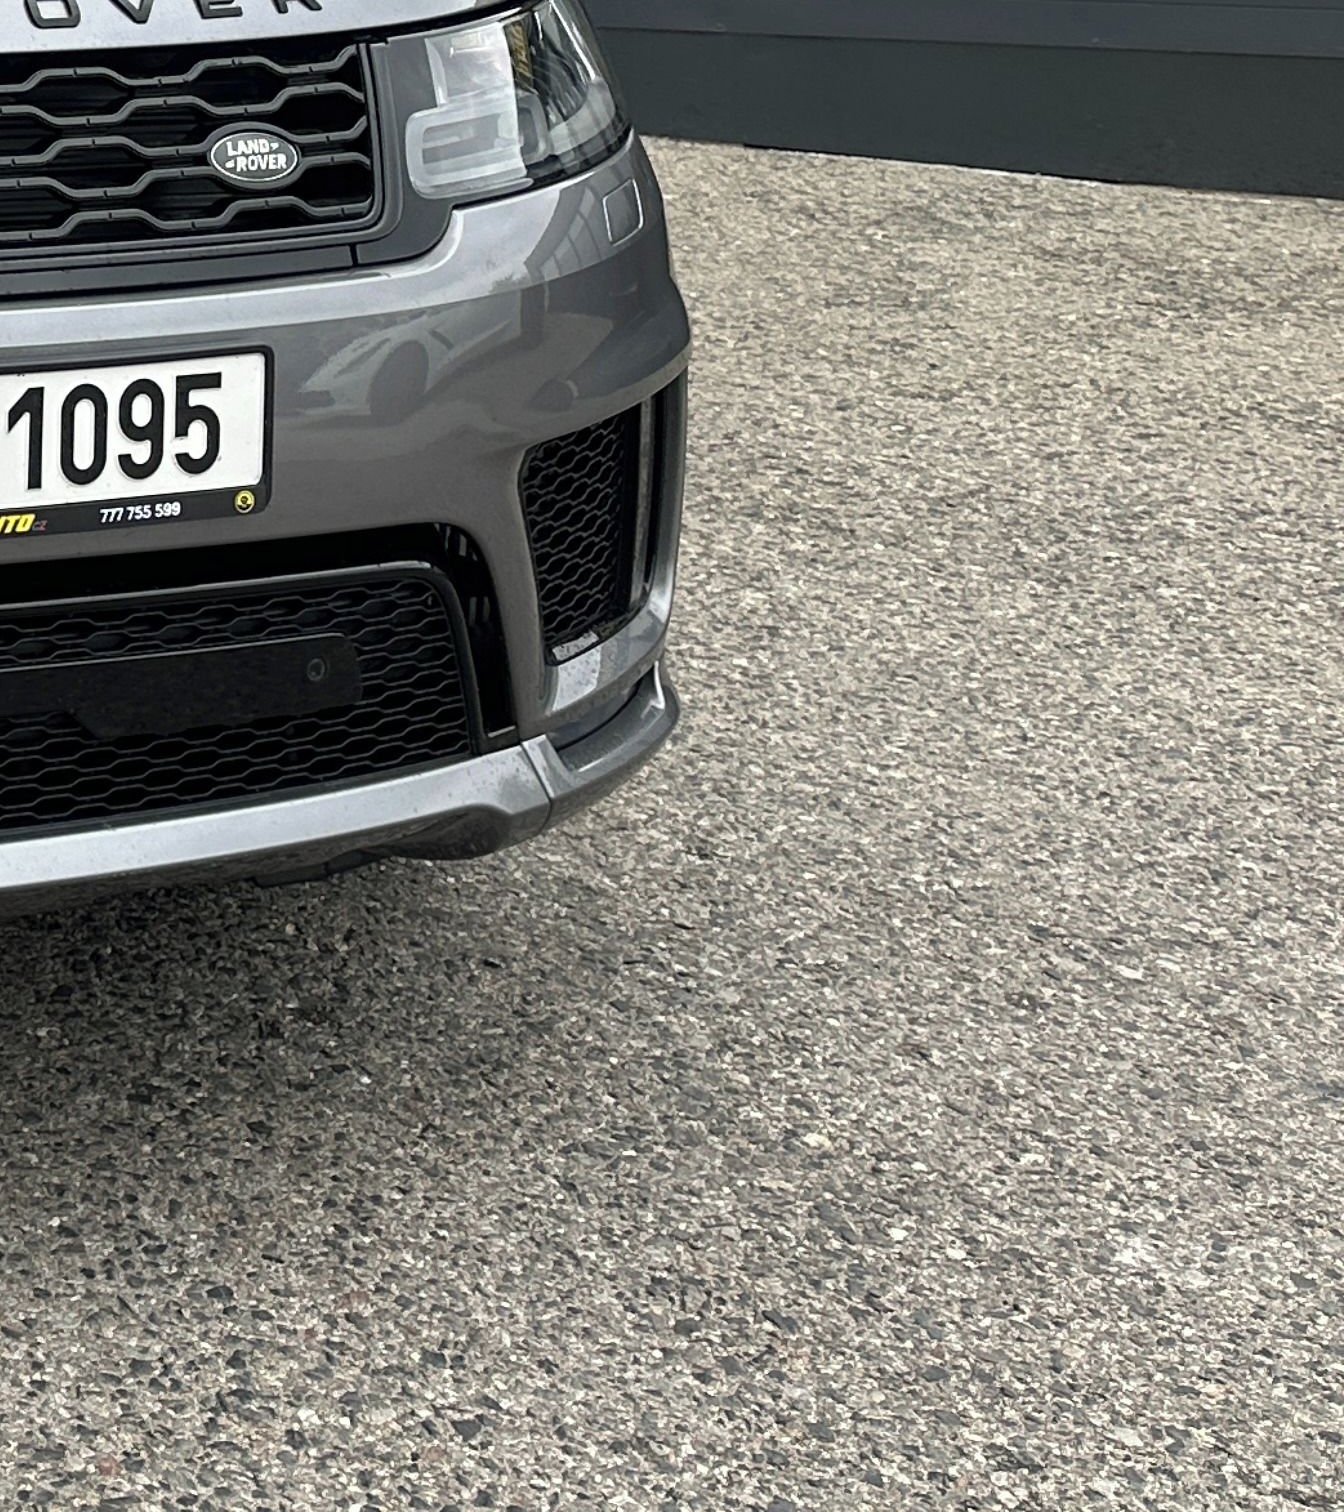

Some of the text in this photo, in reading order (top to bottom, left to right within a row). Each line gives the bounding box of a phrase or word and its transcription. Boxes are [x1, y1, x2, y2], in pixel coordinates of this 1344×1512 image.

[226, 138, 270, 157] LAND
[236, 153, 288, 172] ROVER
[7, 371, 222, 491] 1095
[100, 508, 124, 524] 777
[127, 504, 151, 520] 755
[155, 501, 181, 517] 599
